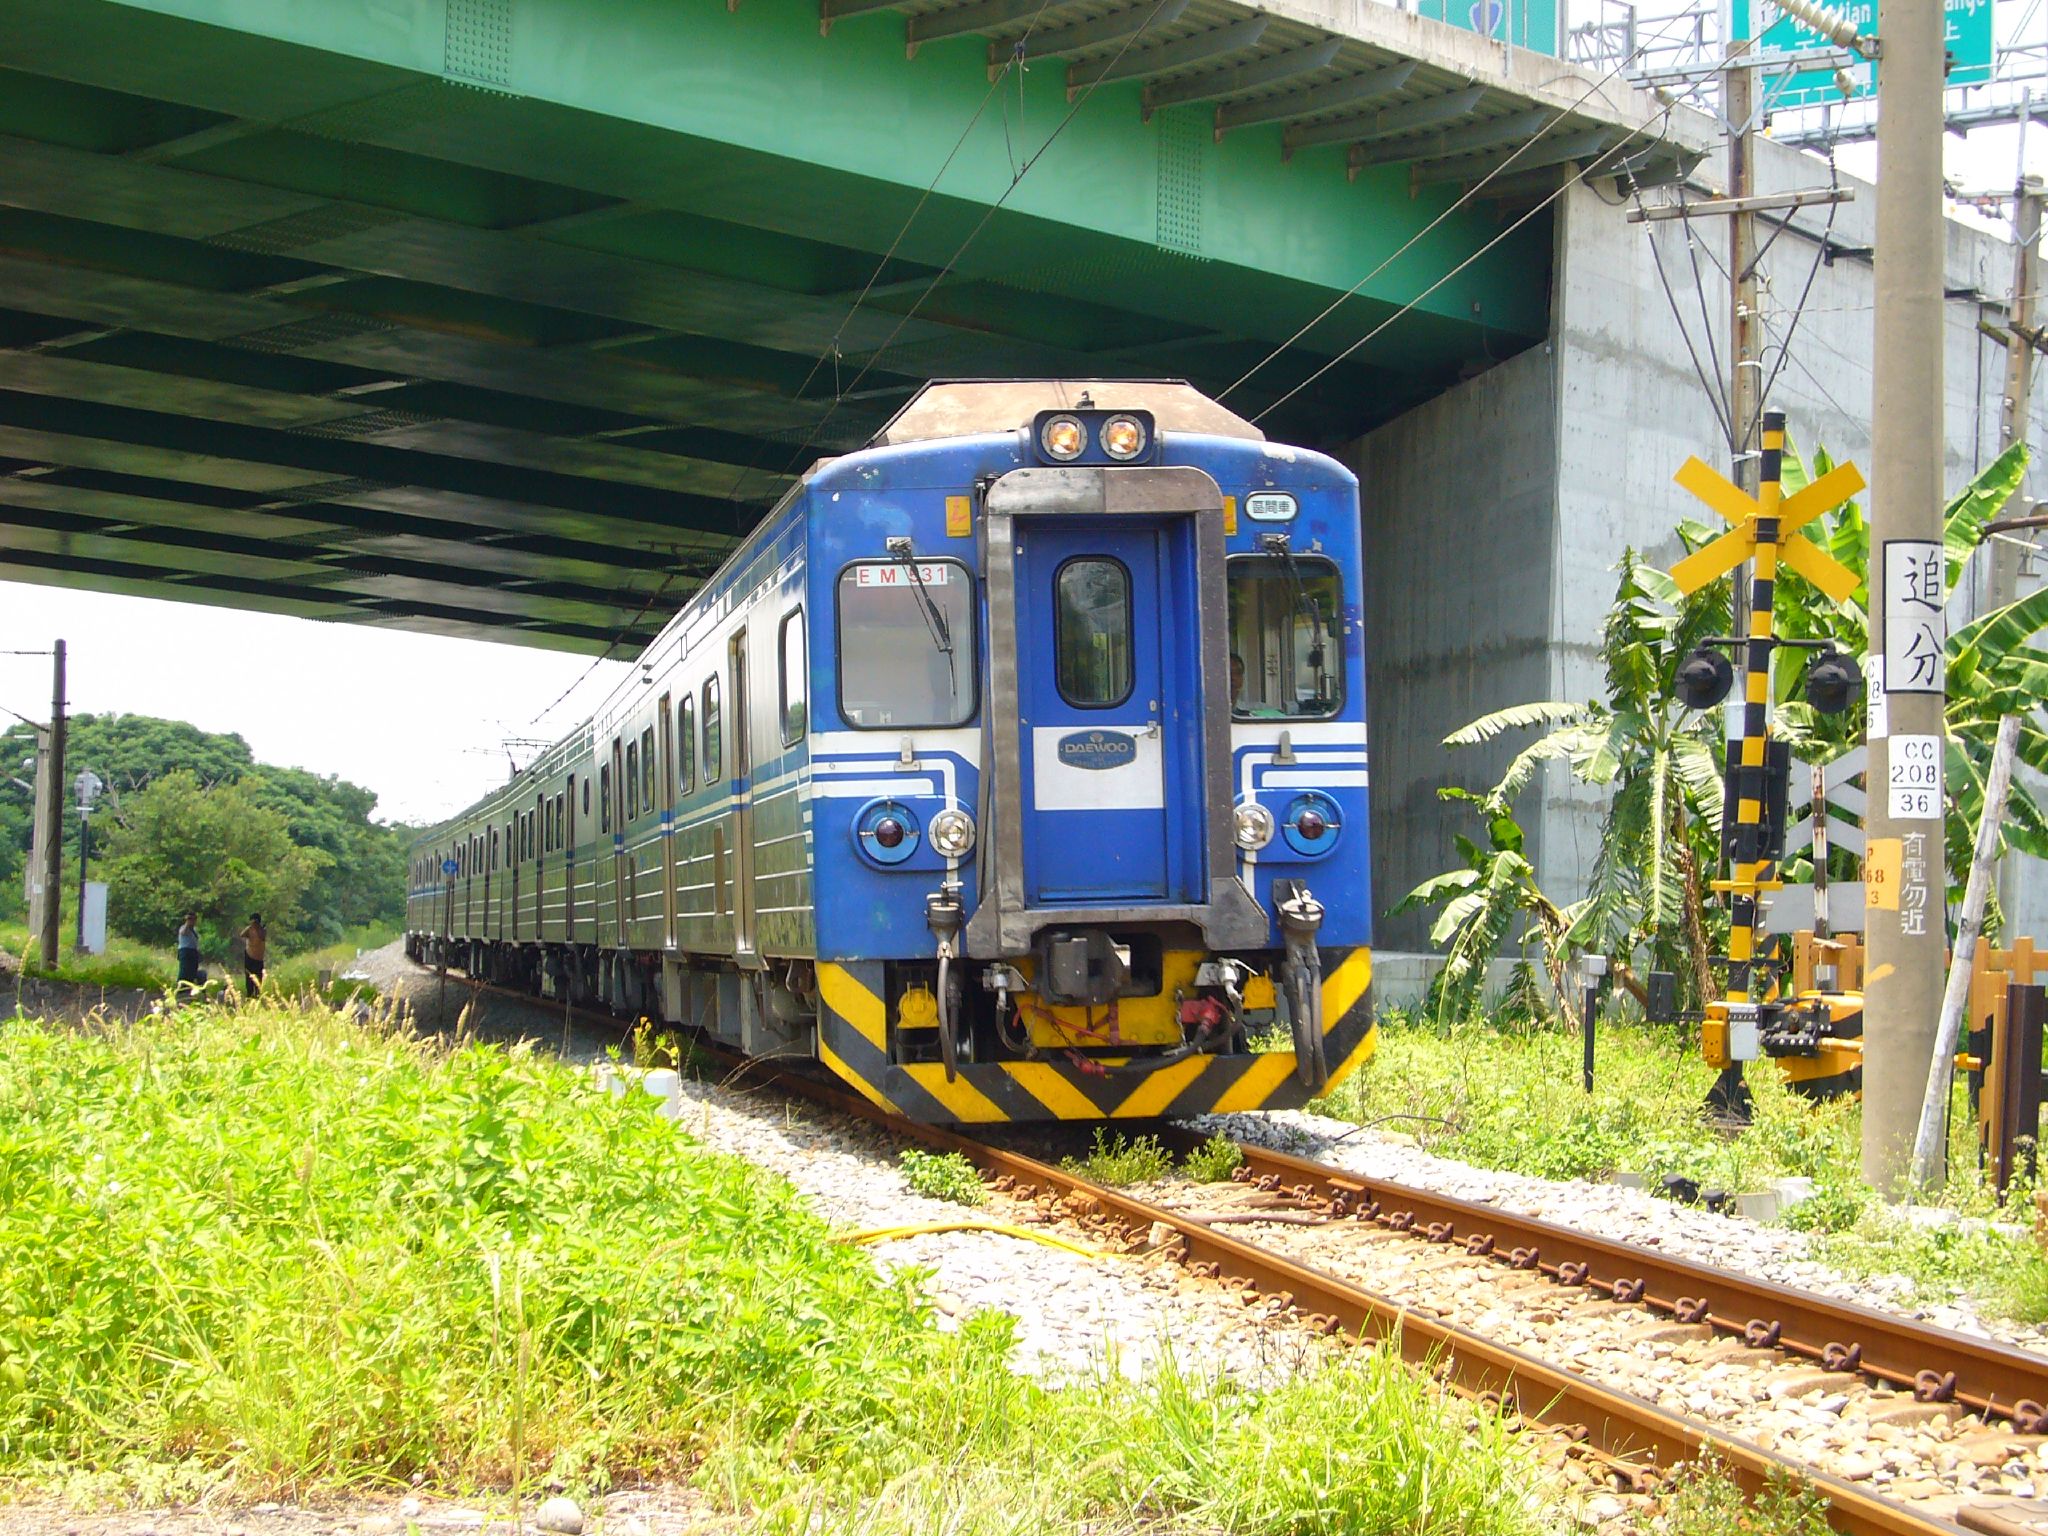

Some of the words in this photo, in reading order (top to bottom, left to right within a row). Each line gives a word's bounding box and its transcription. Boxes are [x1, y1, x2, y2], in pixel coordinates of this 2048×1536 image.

[1252, 500, 1290, 514] 區間車
[1901, 550, 1943, 686] 追分
[1065, 742, 1129, 754] DAEWOO
[1904, 741, 1934, 761] CC
[1891, 764, 1937, 785] 208
[1900, 793, 1929, 814] 36
[1901, 831, 1927, 936] 有電勿近
